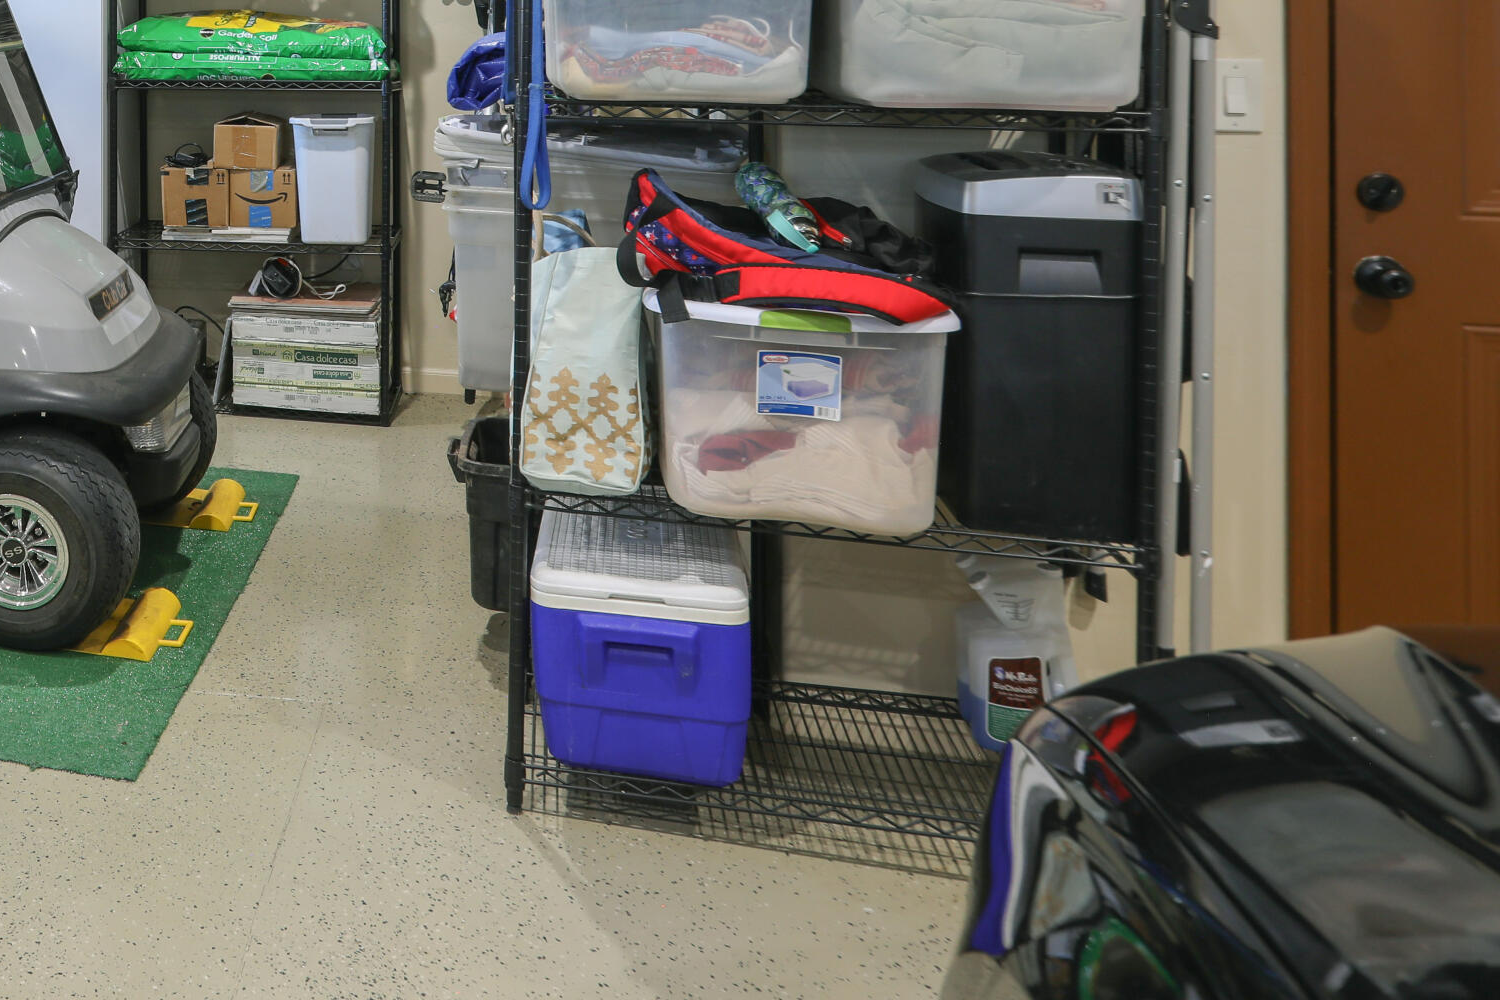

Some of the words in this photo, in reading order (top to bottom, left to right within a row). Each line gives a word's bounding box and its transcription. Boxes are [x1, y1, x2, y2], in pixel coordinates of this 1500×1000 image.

[295, 350, 315, 362] Casa
[316, 353, 338, 364] dolce
[339, 356, 357, 365] casa
[4, 546, 23, 558] SS
